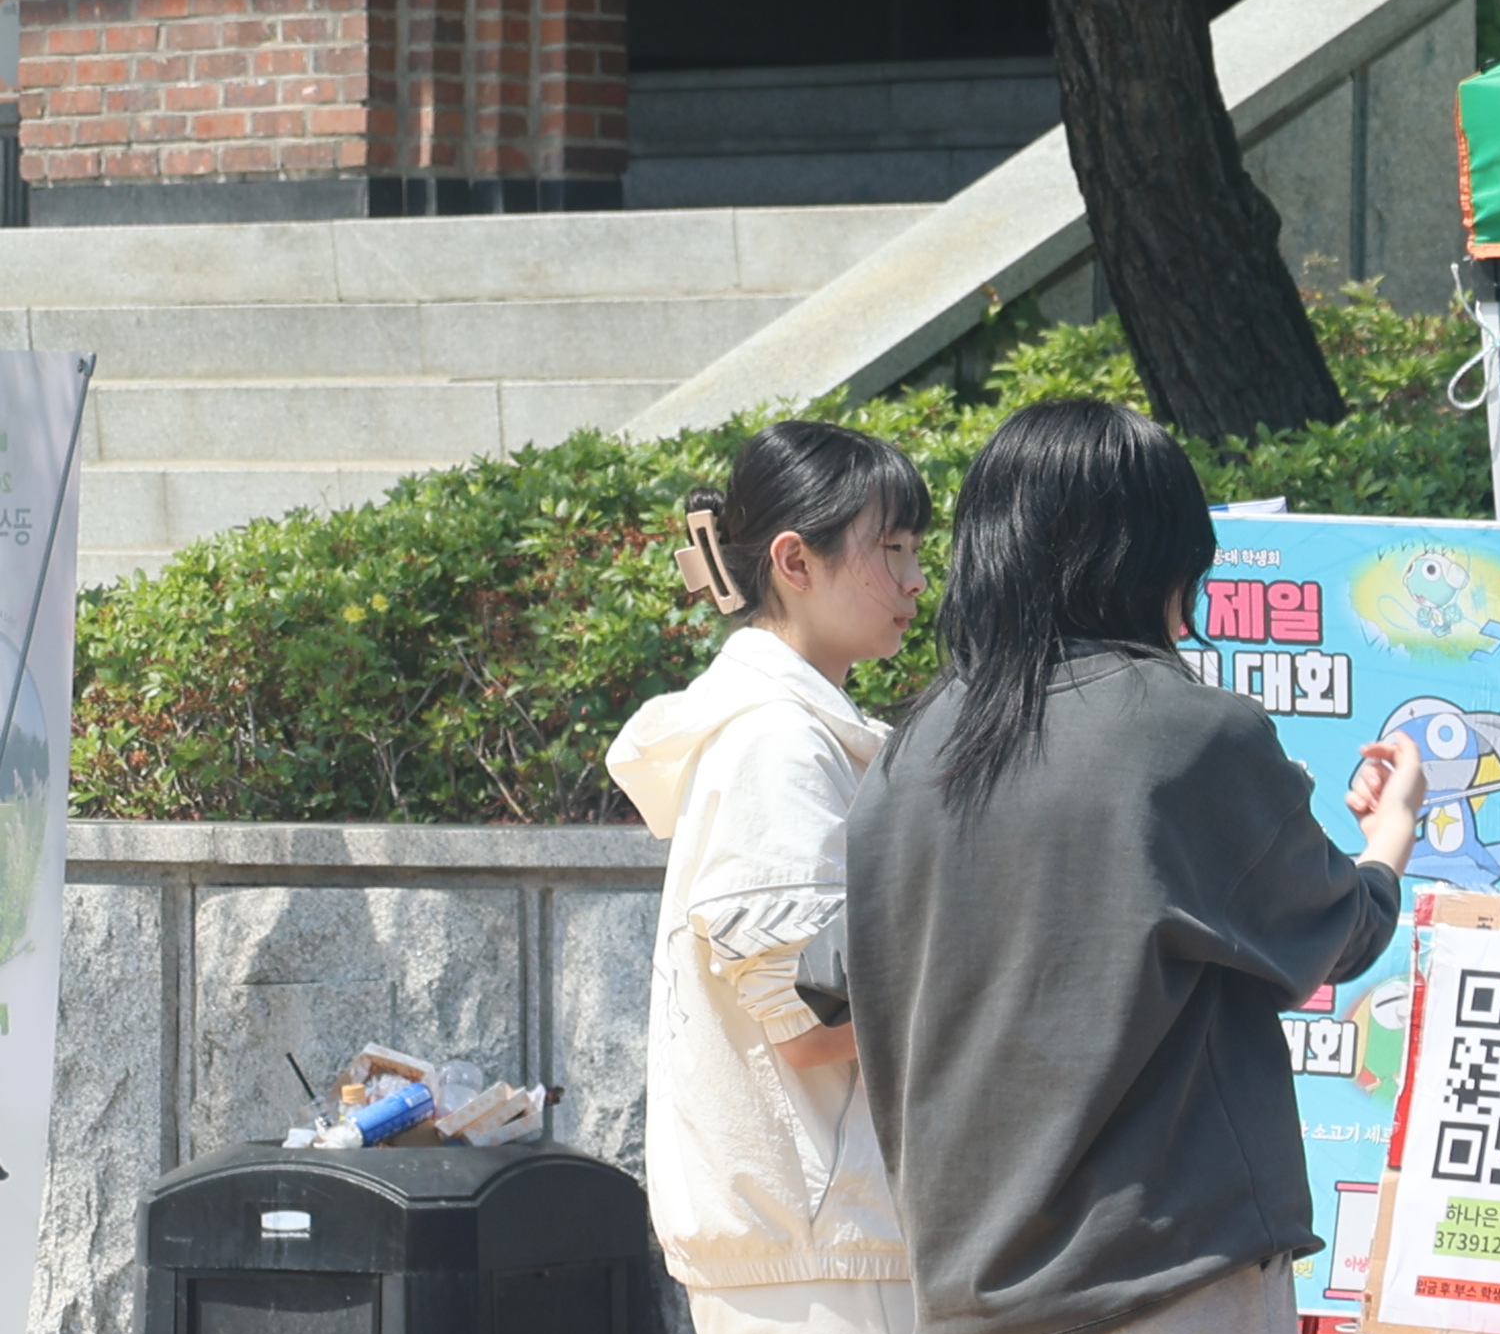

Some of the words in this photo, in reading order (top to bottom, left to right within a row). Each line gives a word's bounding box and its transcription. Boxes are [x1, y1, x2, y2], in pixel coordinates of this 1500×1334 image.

[1241, 549, 1281, 567] 학생회
[1206, 580, 1321, 643] 제일
[1235, 650, 1351, 715] 대회
[1311, 1123, 1361, 1143] 소고기
[1440, 1282, 1451, 1297] 후
[1454, 1283, 1477, 1298] 부스
